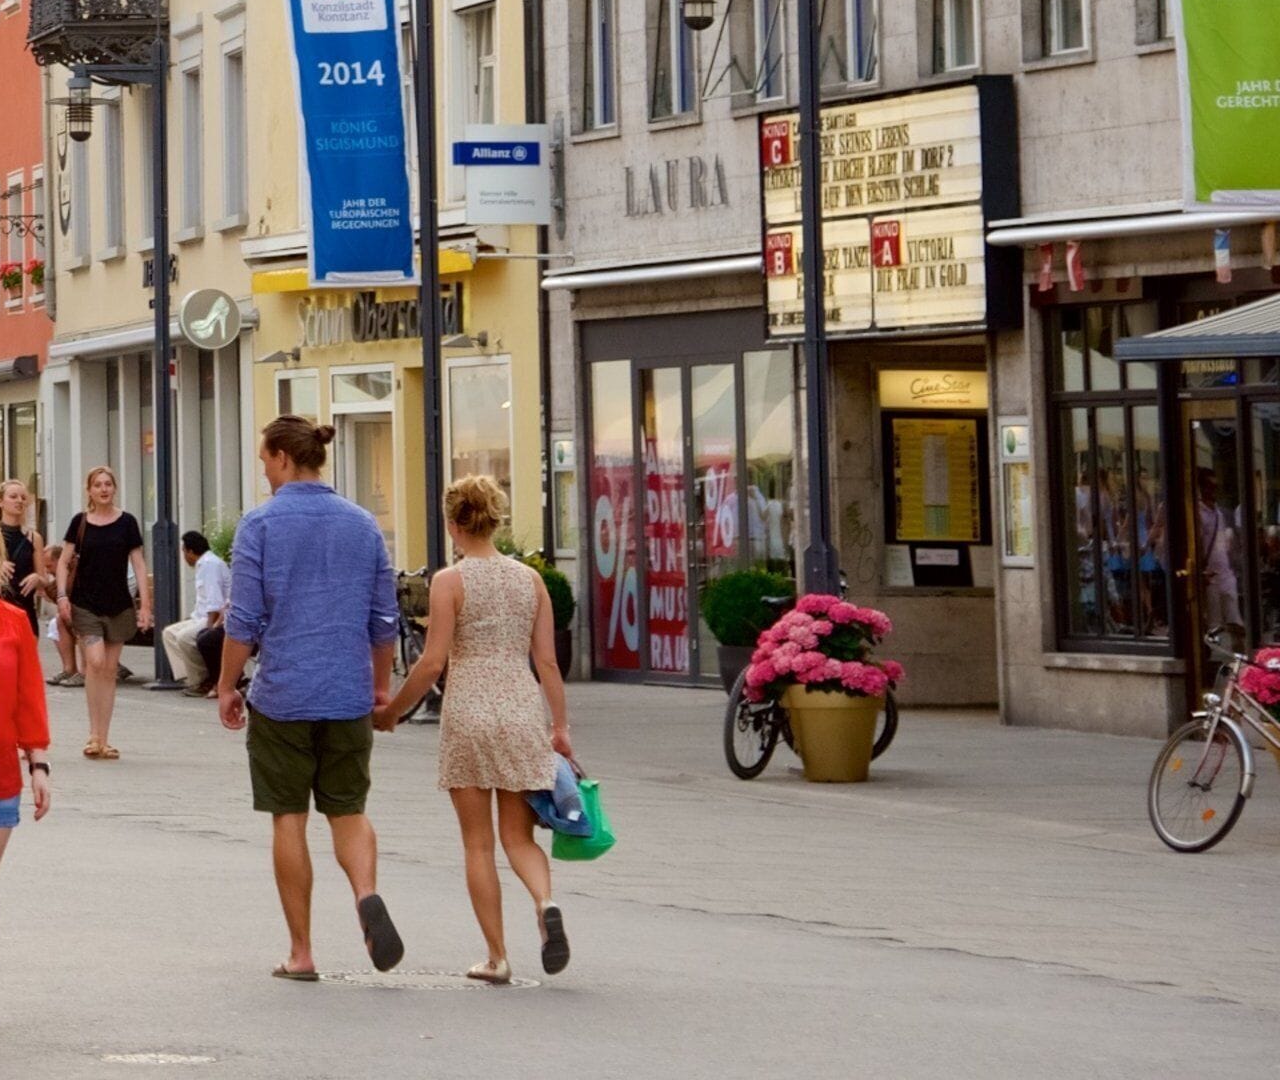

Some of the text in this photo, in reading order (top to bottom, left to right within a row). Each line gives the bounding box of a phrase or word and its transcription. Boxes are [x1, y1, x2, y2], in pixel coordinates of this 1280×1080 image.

[310, 0, 376, 13] Konzilstadt
[317, 10, 370, 22] Konstanz
[317, 59, 386, 87] 2014
[330, 117, 378, 135] KÖNIG
[763, 122, 789, 139] KINO
[315, 134, 400, 152] SIGISMUND
[875, 123, 910, 151] LEBENS
[471, 147, 511, 159] Allianz
[771, 139, 782, 164] C
[902, 150, 915, 174] IM
[921, 146, 944, 171] DORF
[947, 144, 954, 168] 2
[623, 152, 731, 218] LAURA
[342, 197, 387, 210] JAHR DER
[874, 222, 899, 237] KINO
[768, 232, 791, 249] KINO
[907, 237, 955, 264] VICTORIA
[773, 251, 784, 274] B
[881, 241, 894, 265] A
[876, 263, 968, 292] DIE FRAU IN GOLD
